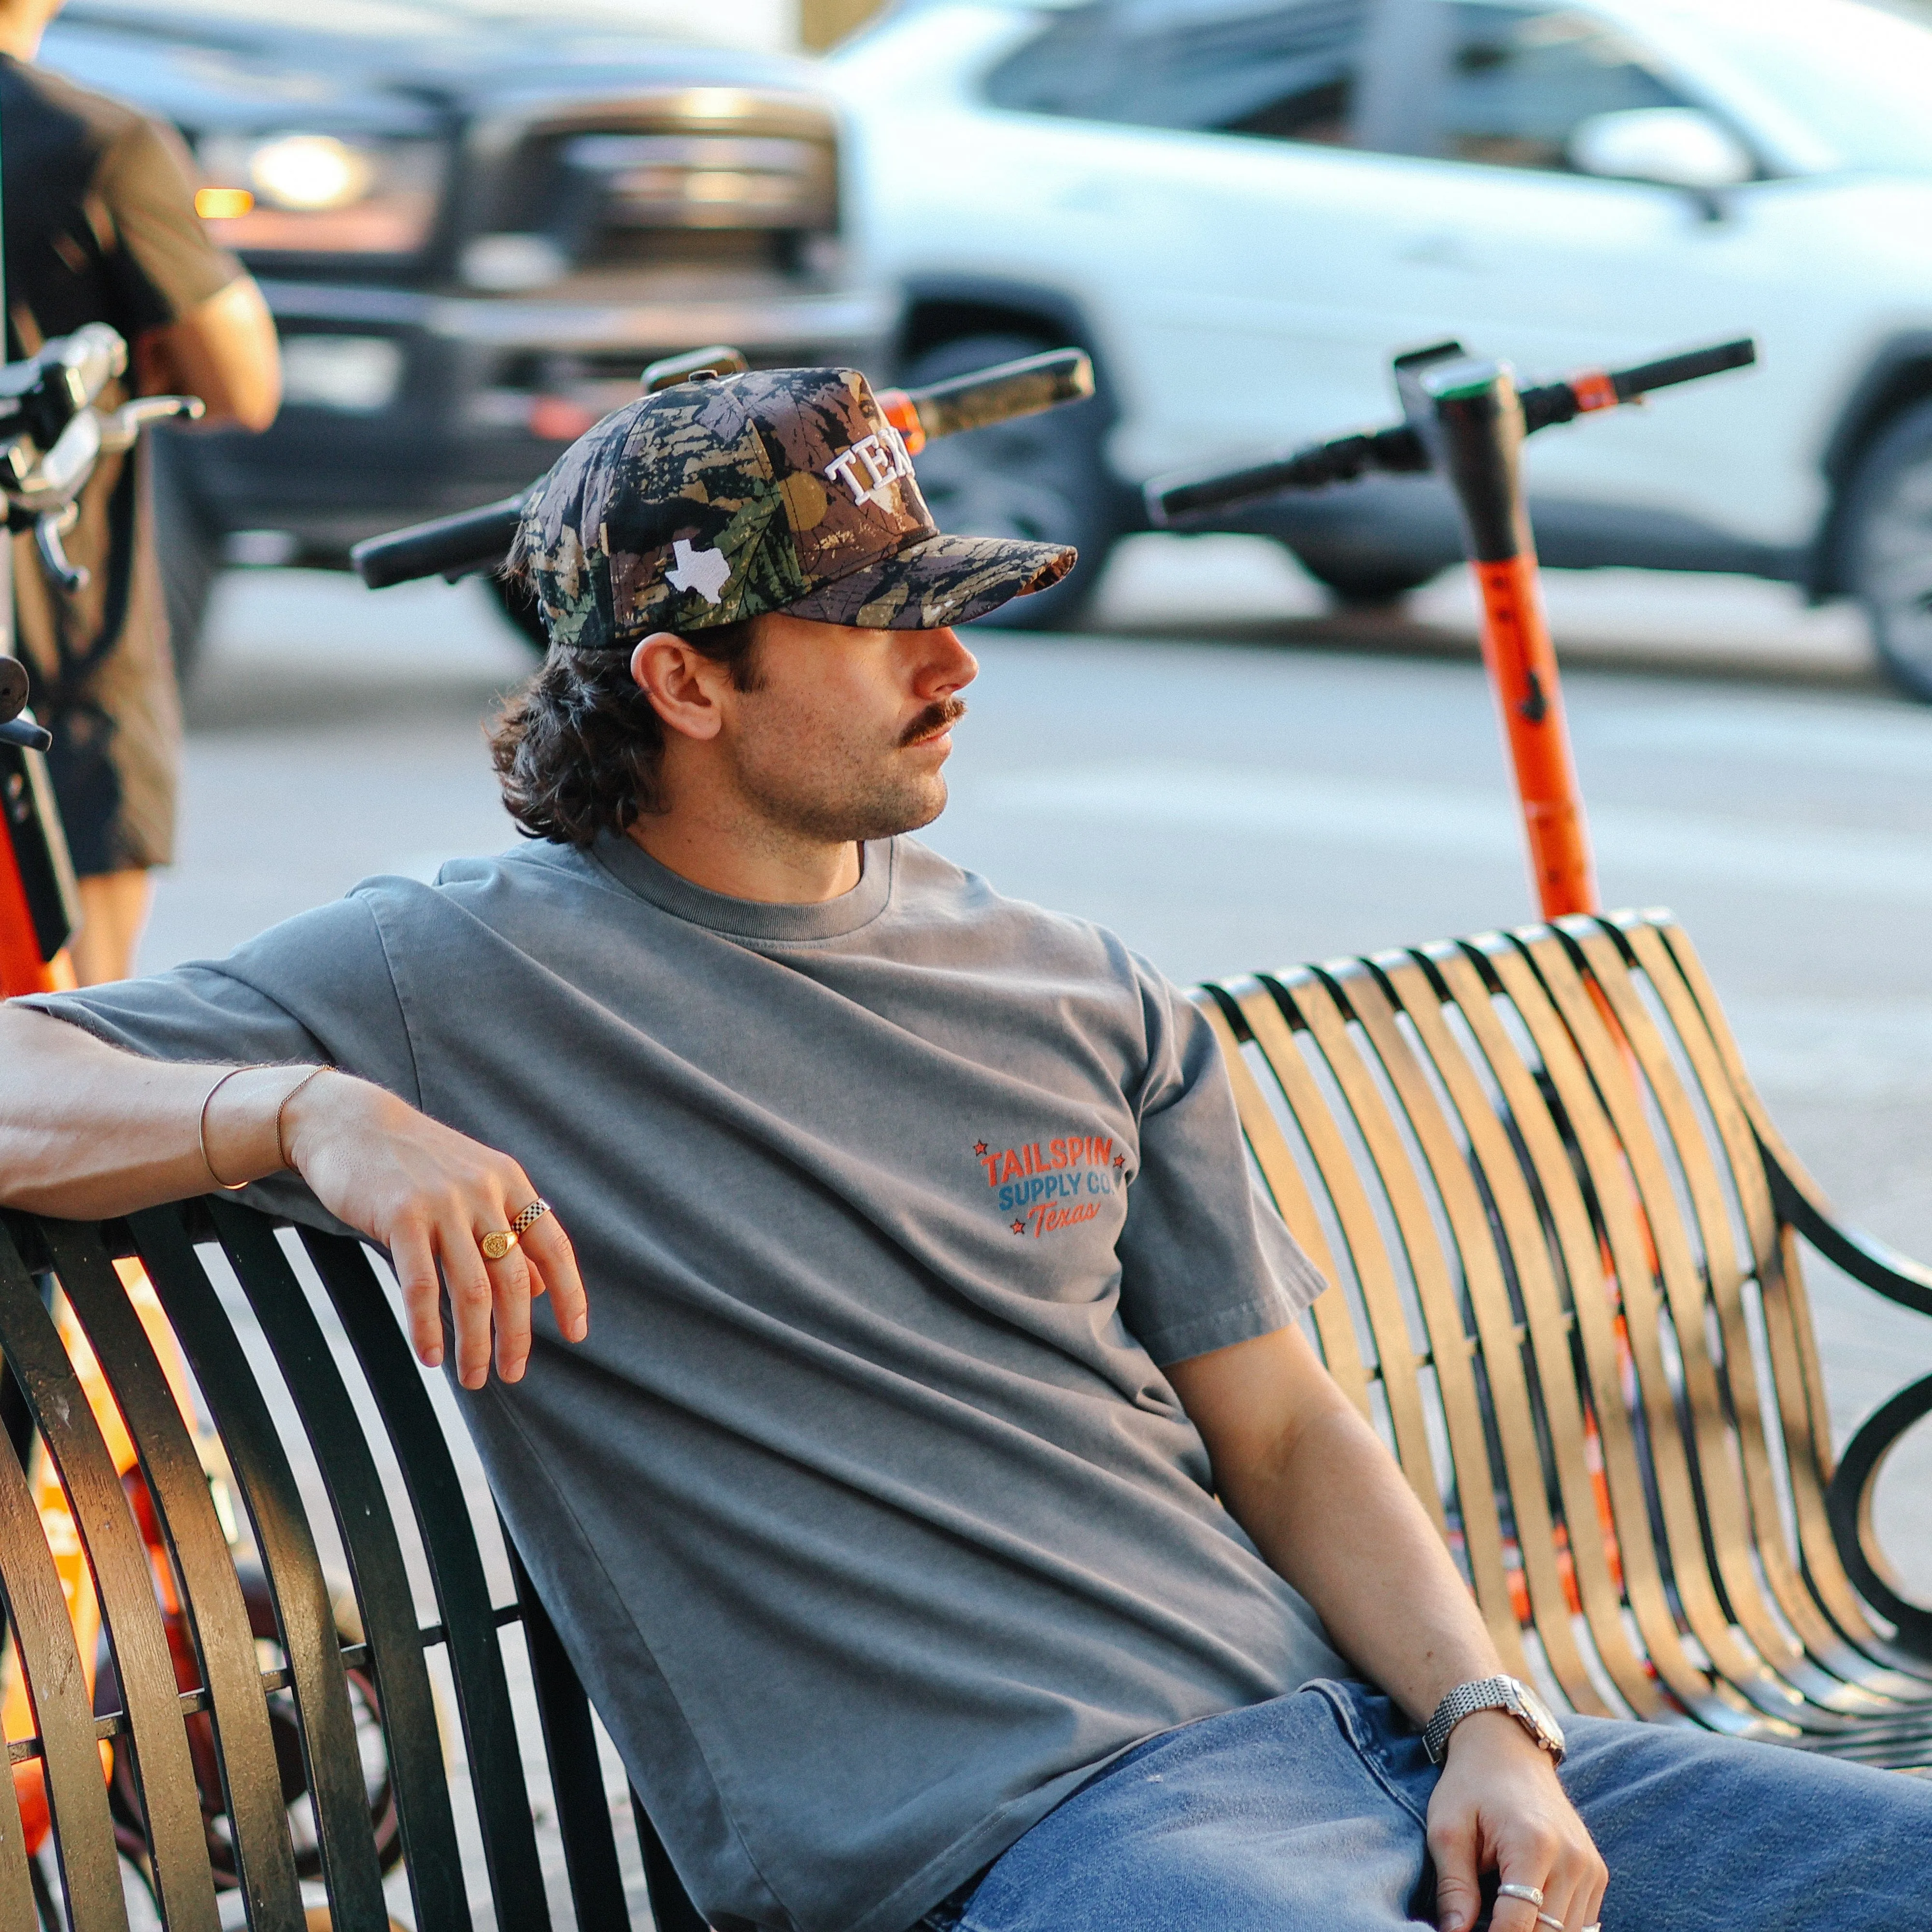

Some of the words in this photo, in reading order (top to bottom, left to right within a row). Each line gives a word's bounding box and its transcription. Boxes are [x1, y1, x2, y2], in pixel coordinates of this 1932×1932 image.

[824, 426, 915, 506] TEX
[980, 1136, 1112, 1187] TAILSPIN
[998, 1172, 1081, 1210] SUPPLY
[1027, 1201, 1101, 1238] Texas
